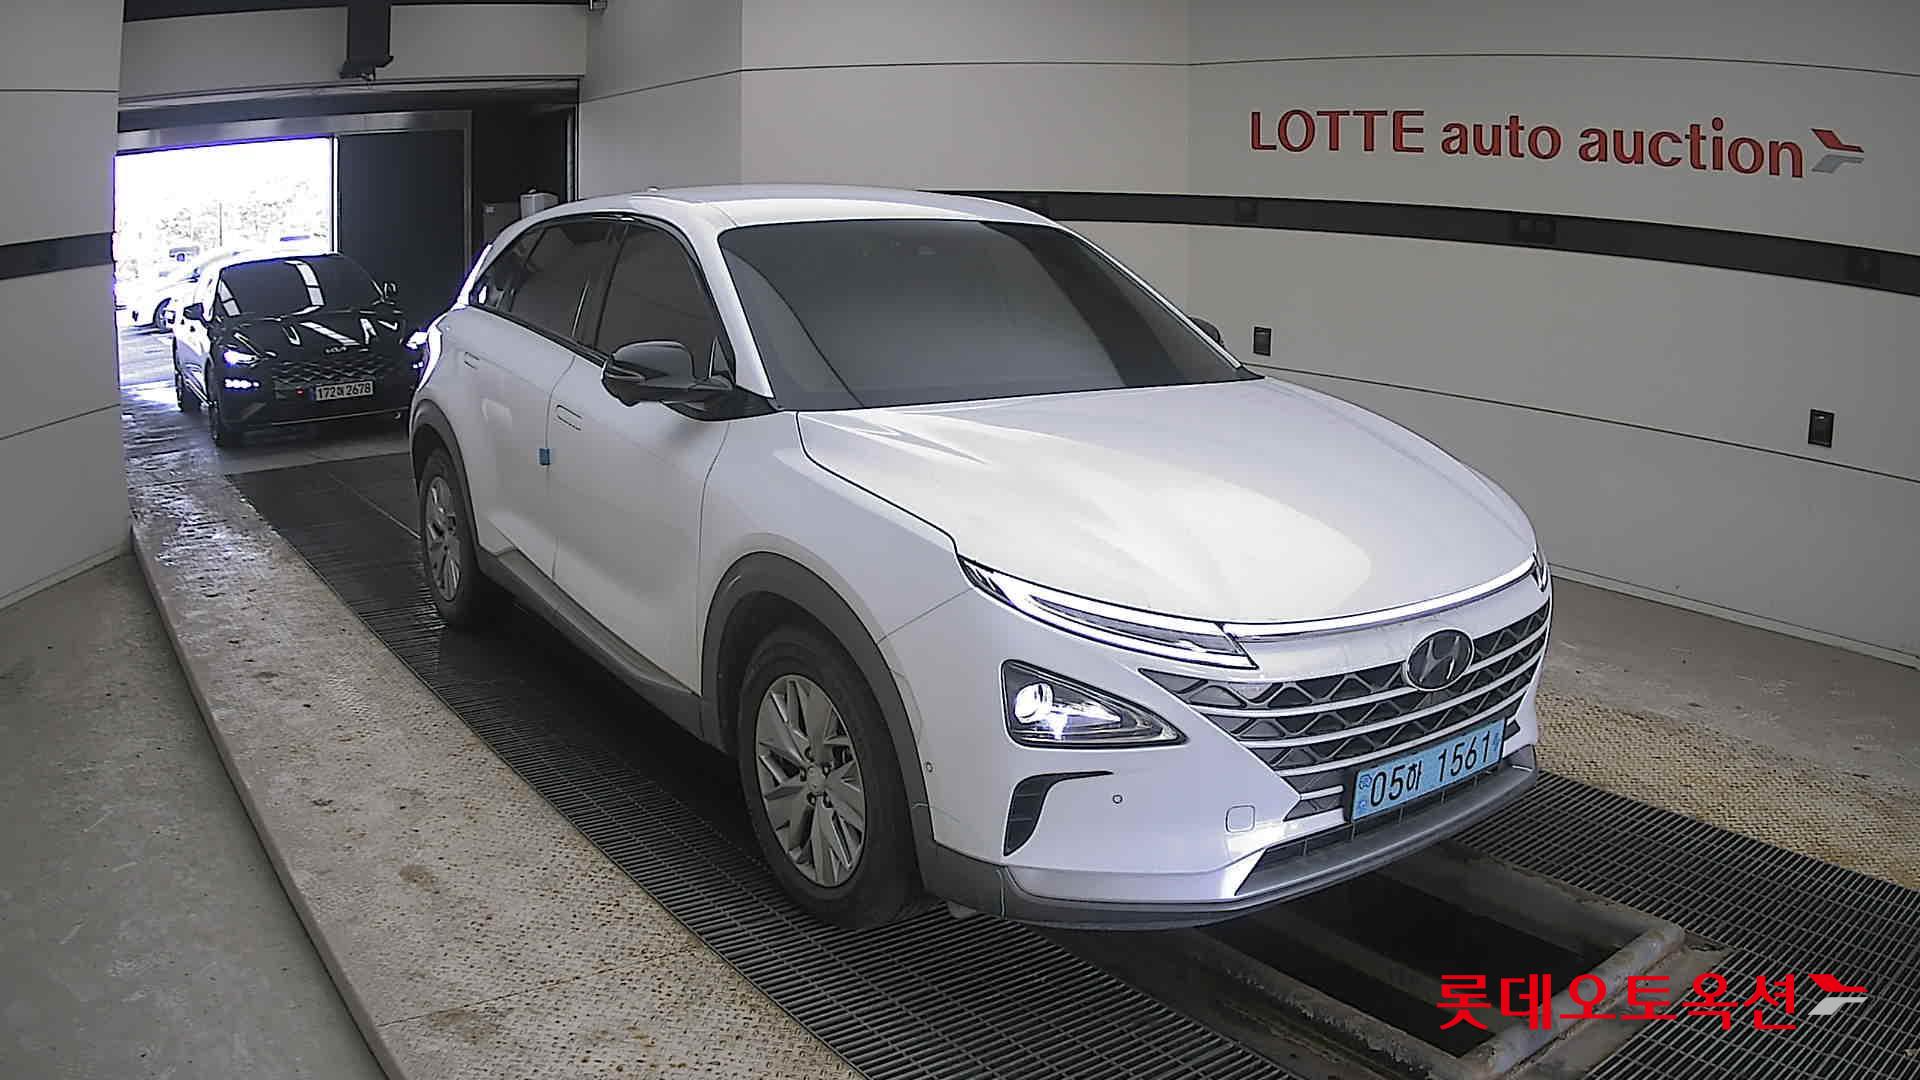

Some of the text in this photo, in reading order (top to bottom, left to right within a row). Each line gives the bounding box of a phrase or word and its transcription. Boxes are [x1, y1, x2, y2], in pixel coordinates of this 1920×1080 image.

[1250, 110, 1804, 178] LOTTE auto auction
[346, 382, 372, 395] 2678
[1370, 730, 1490, 807] 05하 1561
